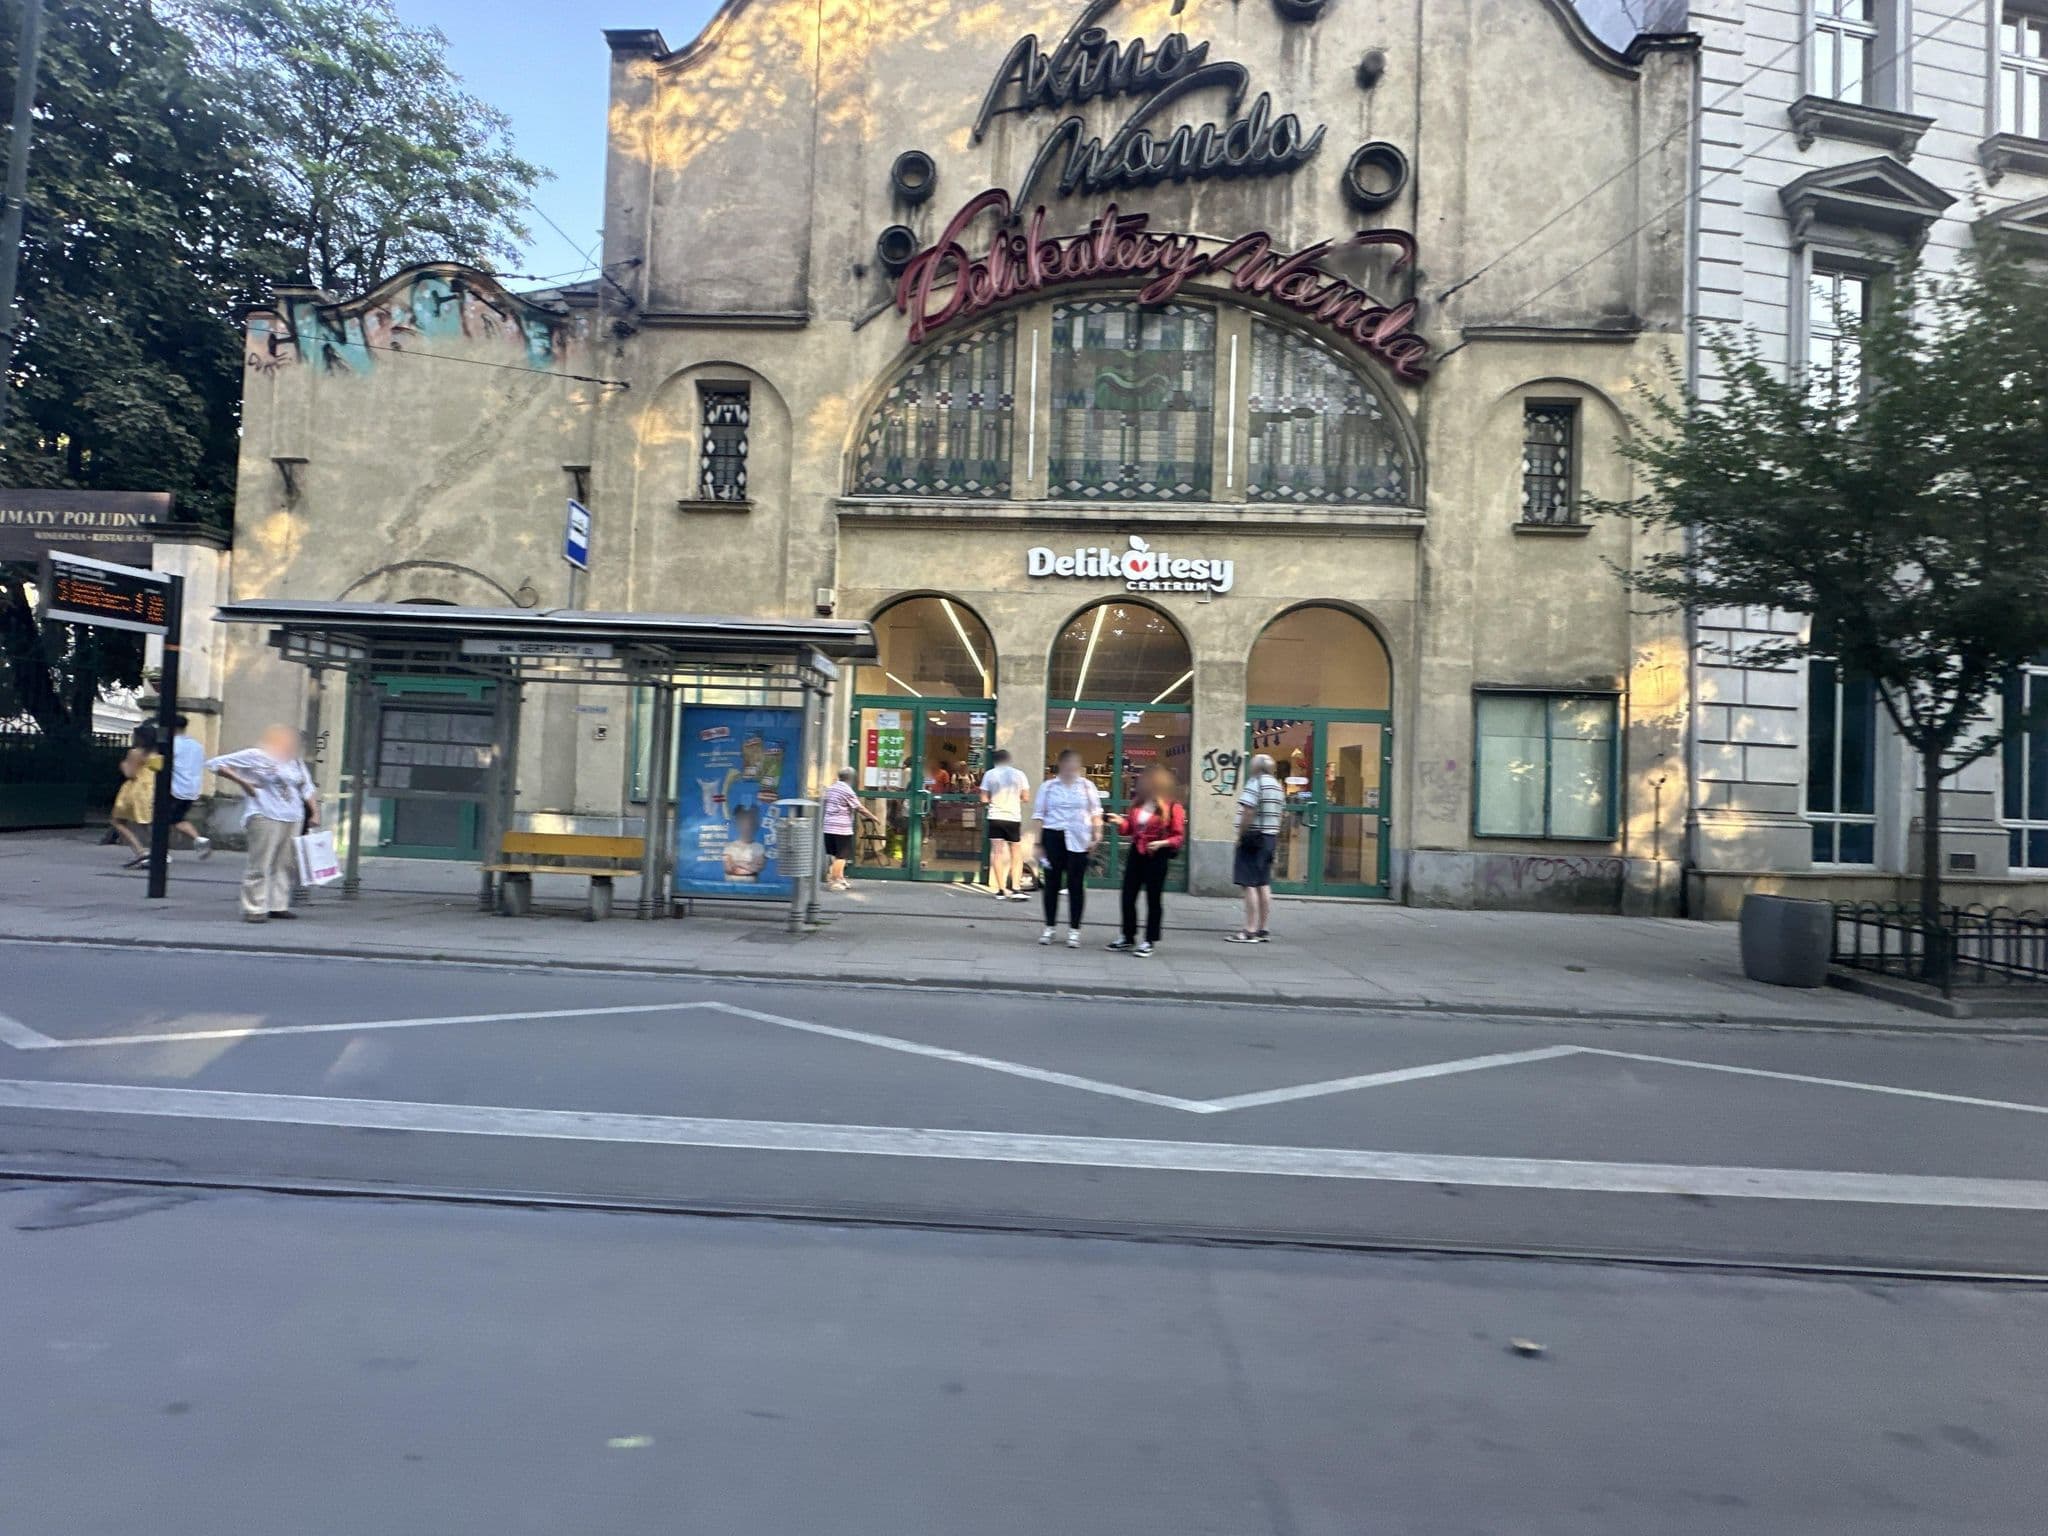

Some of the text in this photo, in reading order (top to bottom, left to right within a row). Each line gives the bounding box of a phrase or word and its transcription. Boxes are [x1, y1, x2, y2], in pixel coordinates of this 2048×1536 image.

[1012, 61, 1328, 226] Wanda
[898, 187, 1431, 388] Delikatesy Wanda
[1027, 546, 1234, 593] Delikatesy
[1126, 581, 1208, 592] CENTRUM
